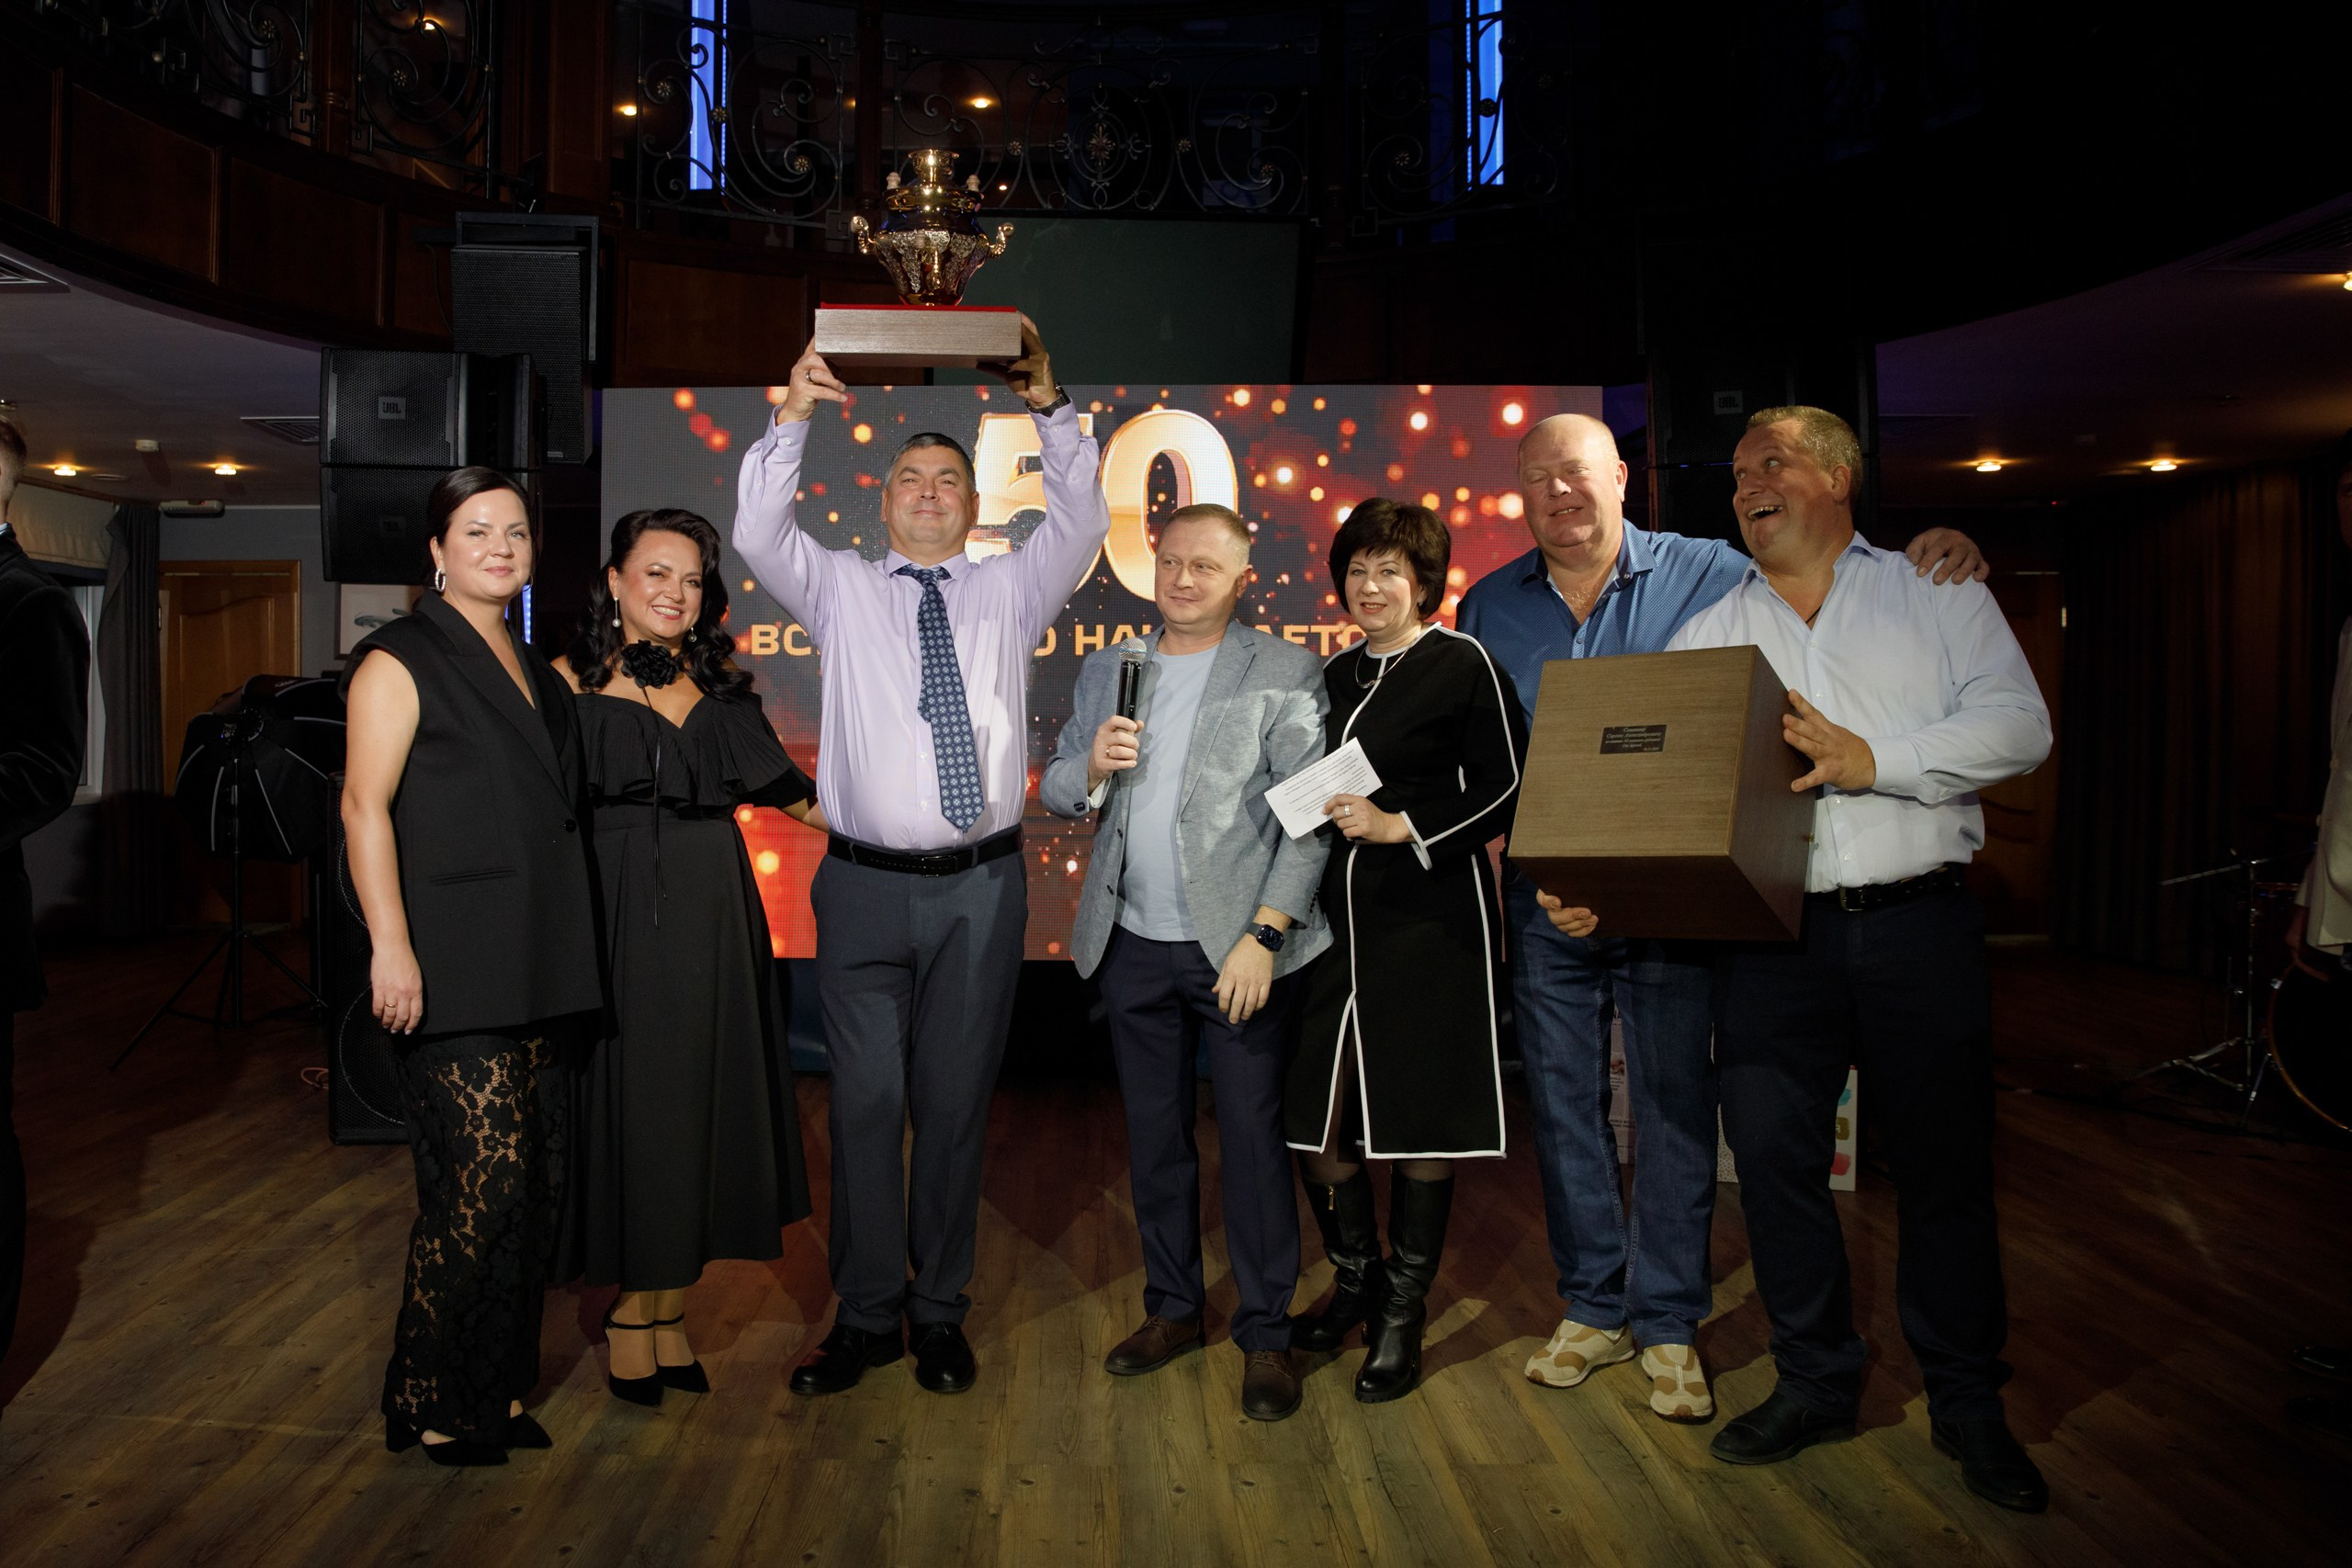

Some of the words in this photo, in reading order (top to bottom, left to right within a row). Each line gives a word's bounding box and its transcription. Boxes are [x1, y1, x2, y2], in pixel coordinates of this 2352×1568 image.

[382, 402, 401, 413] JBL
[966, 410, 1238, 602] 50
[751, 623, 821, 657] ВС
